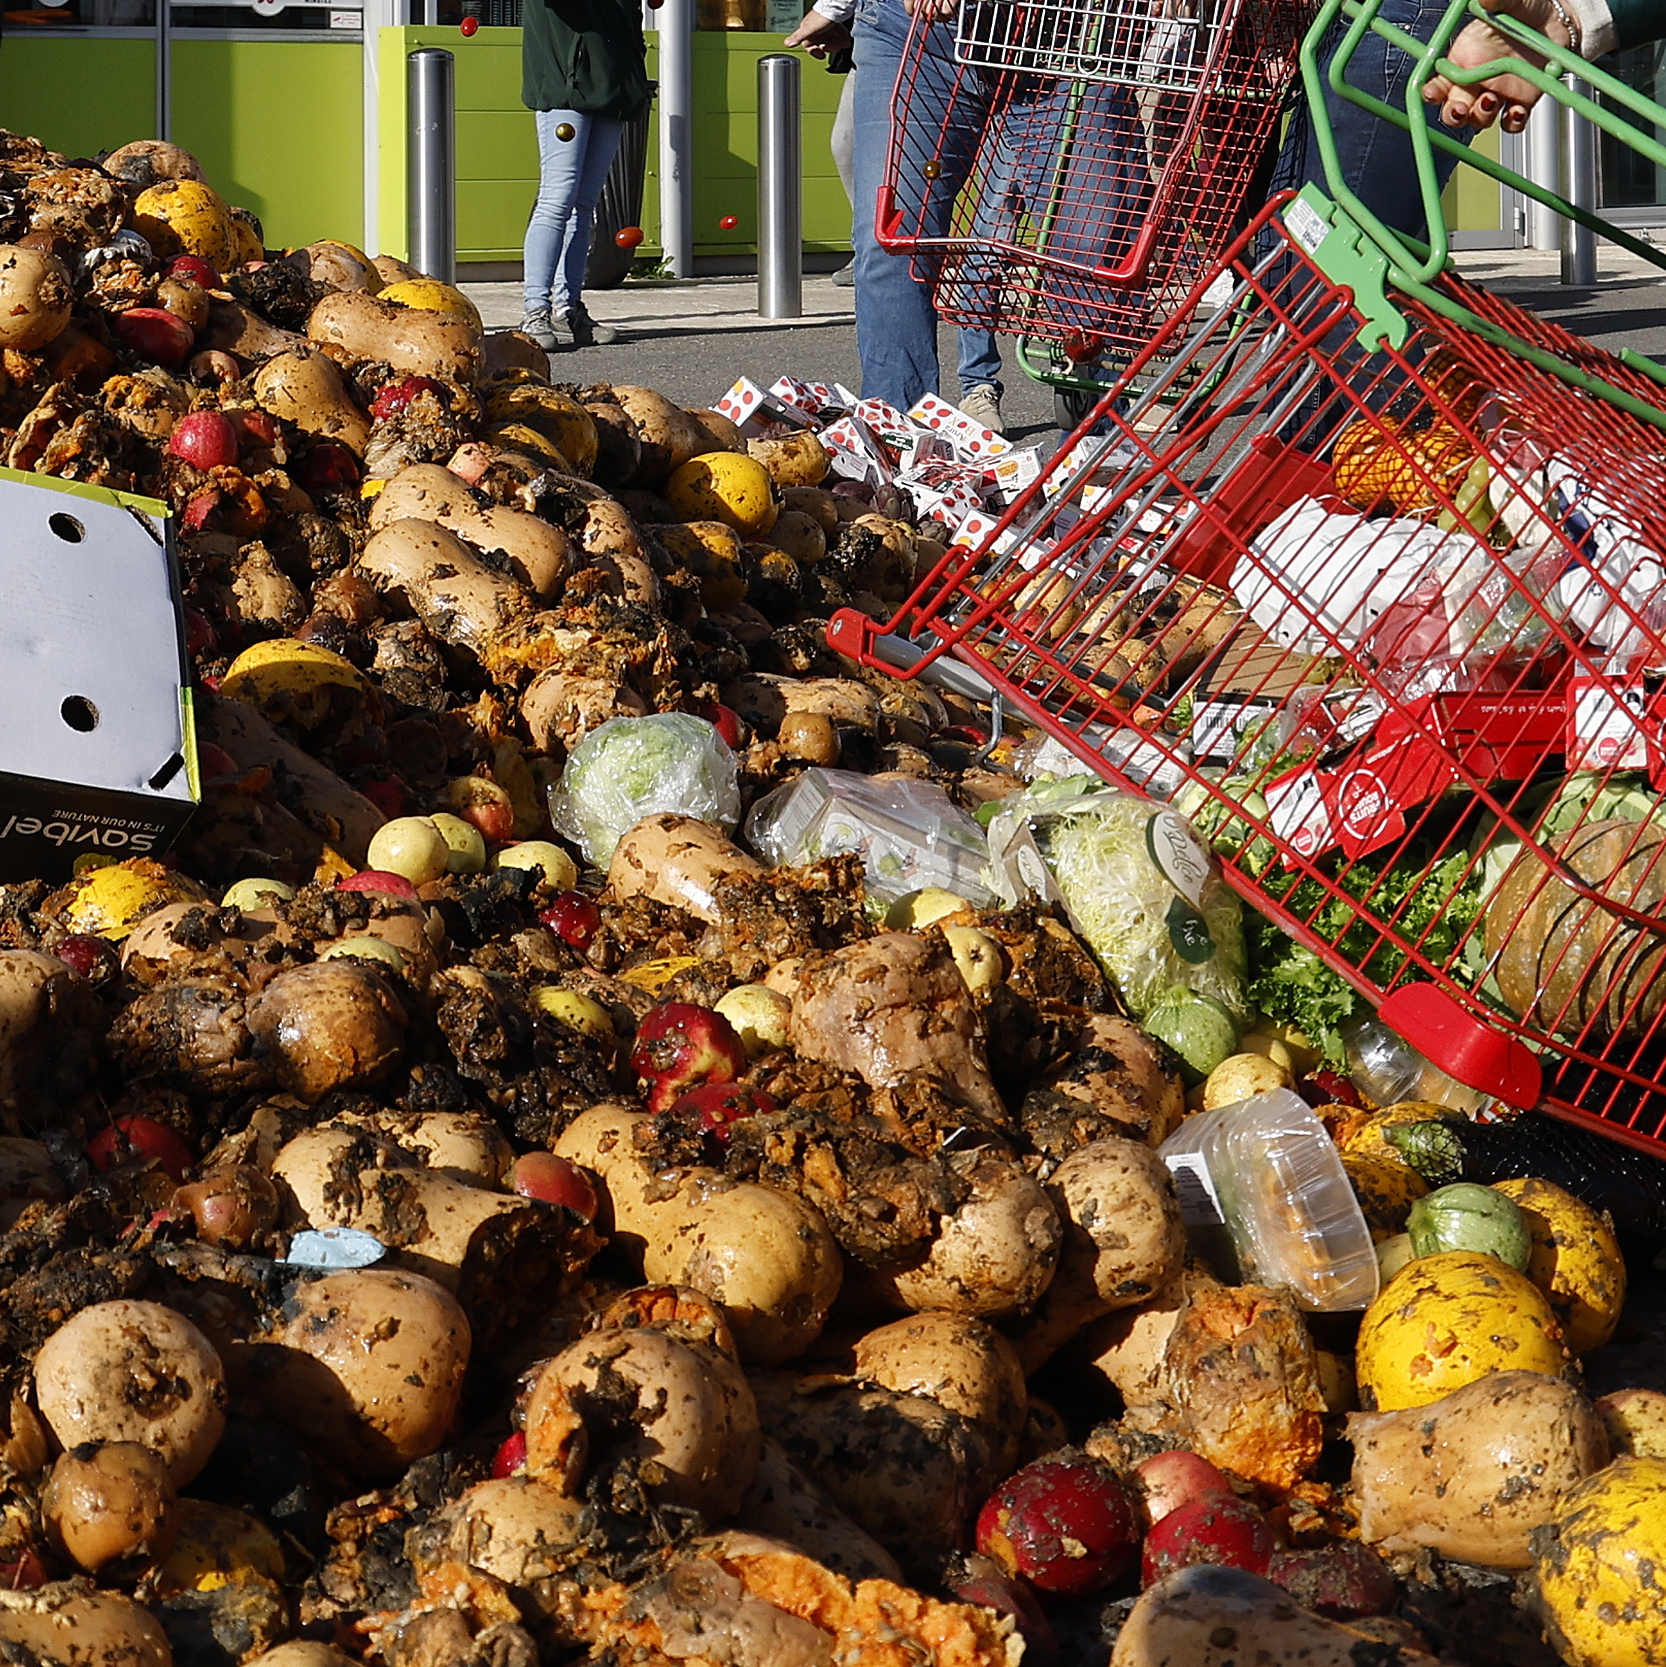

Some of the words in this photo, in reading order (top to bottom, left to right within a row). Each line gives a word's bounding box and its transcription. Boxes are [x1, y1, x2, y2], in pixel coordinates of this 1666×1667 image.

[52, 809, 102, 824] NATURE
[102, 817, 126, 828] OUR
[129, 820, 143, 830] IN
[143, 822, 165, 833] IT'S
